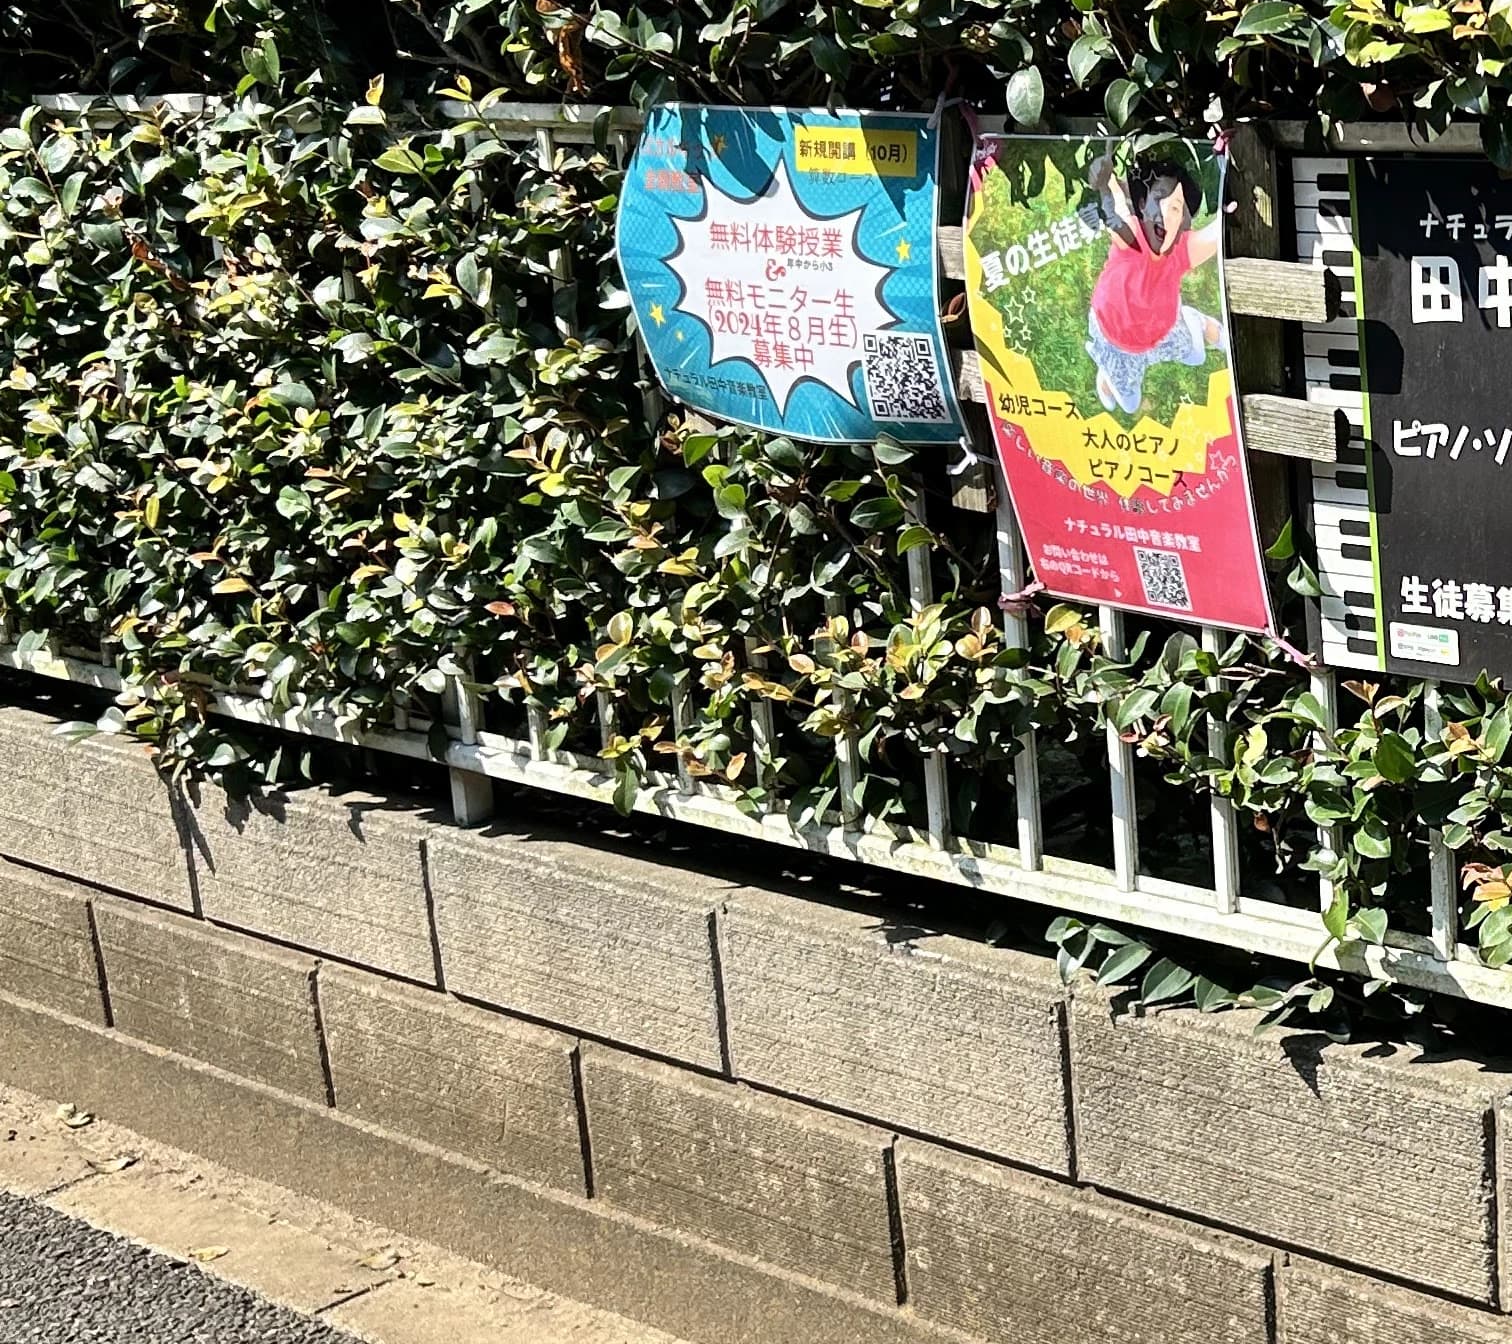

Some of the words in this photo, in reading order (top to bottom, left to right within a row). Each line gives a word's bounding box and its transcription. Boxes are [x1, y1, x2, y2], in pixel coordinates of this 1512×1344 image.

[709, 220, 844, 259] 無料体験授業
[765, 258, 787, 281] &
[705, 278, 856, 321] 無料モニター生
[751, 337, 815, 372] 募集中
[999, 392, 1080, 420] 幼児コース
[1082, 427, 1180, 456] 大人のピアノ
[1089, 459, 1187, 488] ピアノコース
[1064, 517, 1202, 553] ナチュラル田中音楽教室
